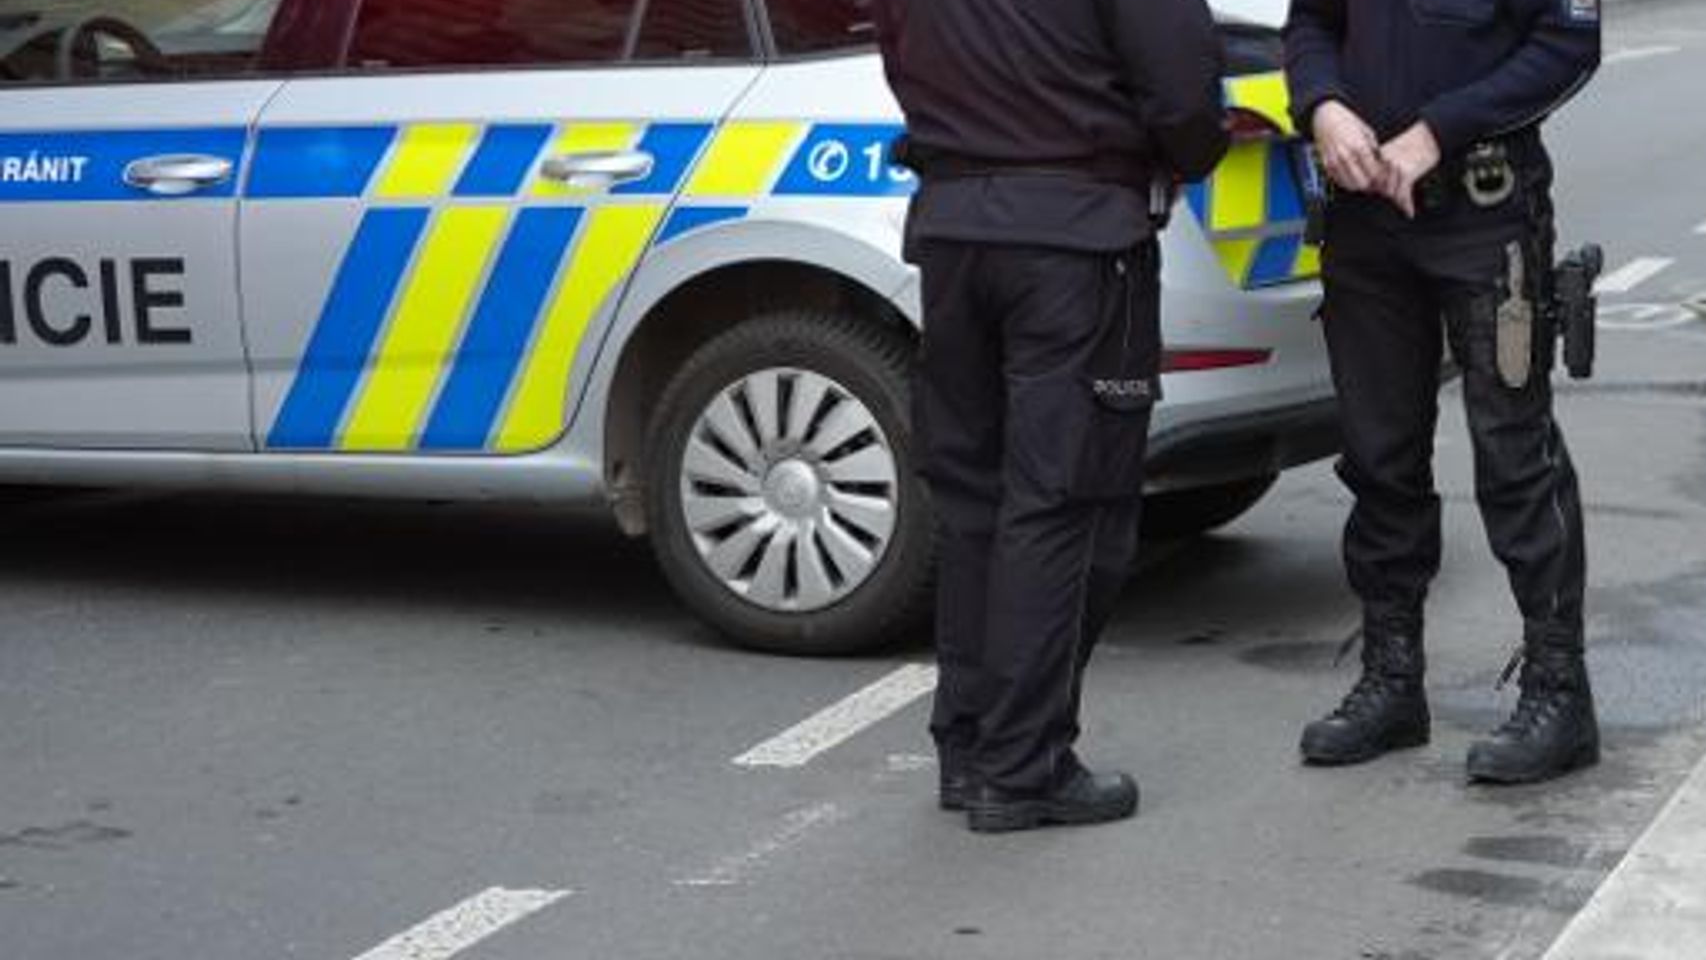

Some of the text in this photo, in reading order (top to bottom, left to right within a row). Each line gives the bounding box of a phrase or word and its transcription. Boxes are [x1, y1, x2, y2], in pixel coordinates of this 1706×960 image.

[3, 149, 89, 182] RÁNIT
[0, 257, 192, 347] ICIE
[1093, 379, 1149, 396] POLICIE
